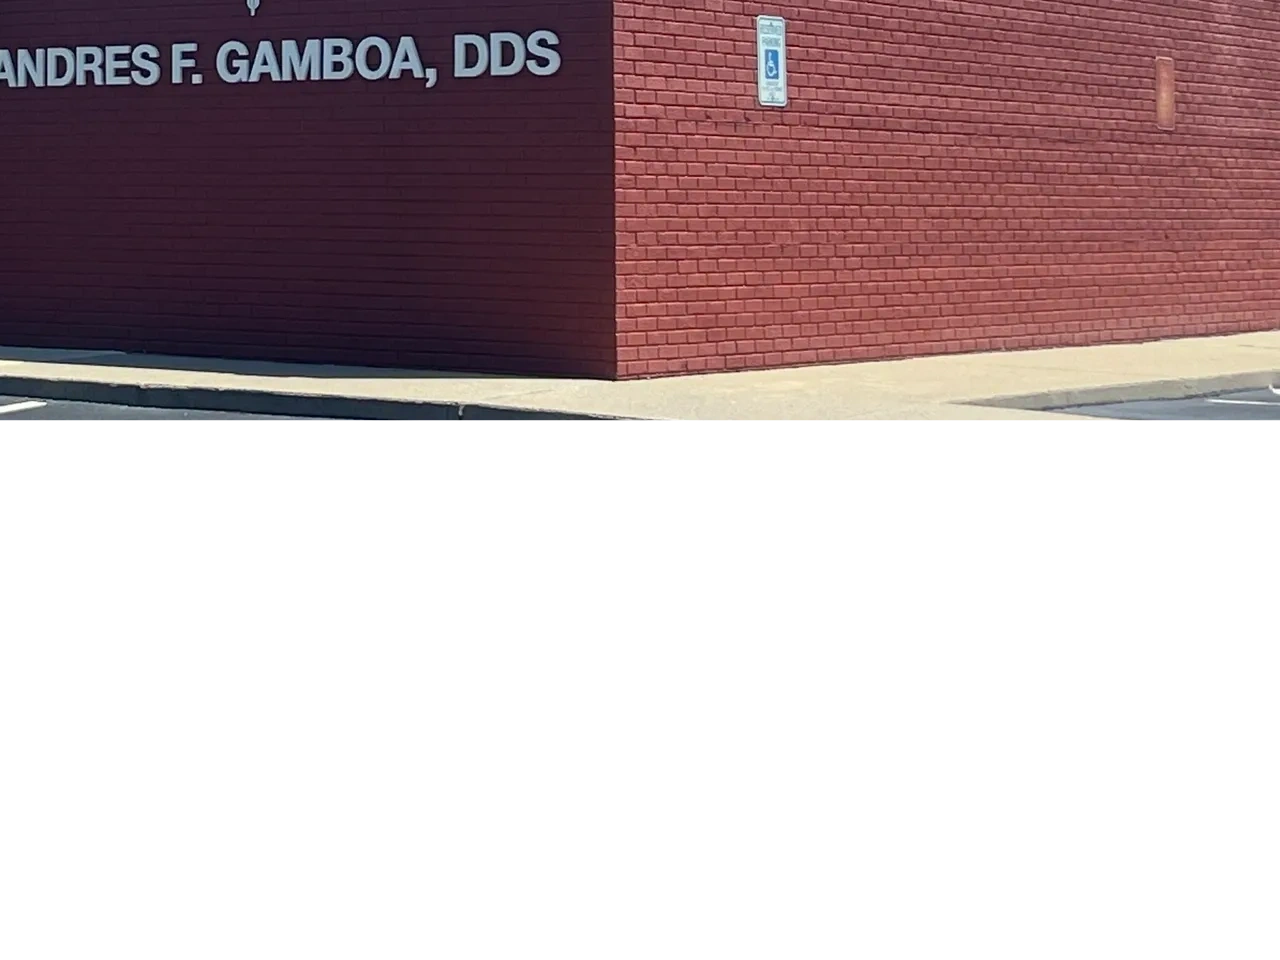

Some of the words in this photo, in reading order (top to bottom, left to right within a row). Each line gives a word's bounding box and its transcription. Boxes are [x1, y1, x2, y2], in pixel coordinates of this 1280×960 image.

[171, 43, 203, 84] F.
[215, 36, 438, 88] GAMBOA,
[453, 30, 561, 76] DDS
